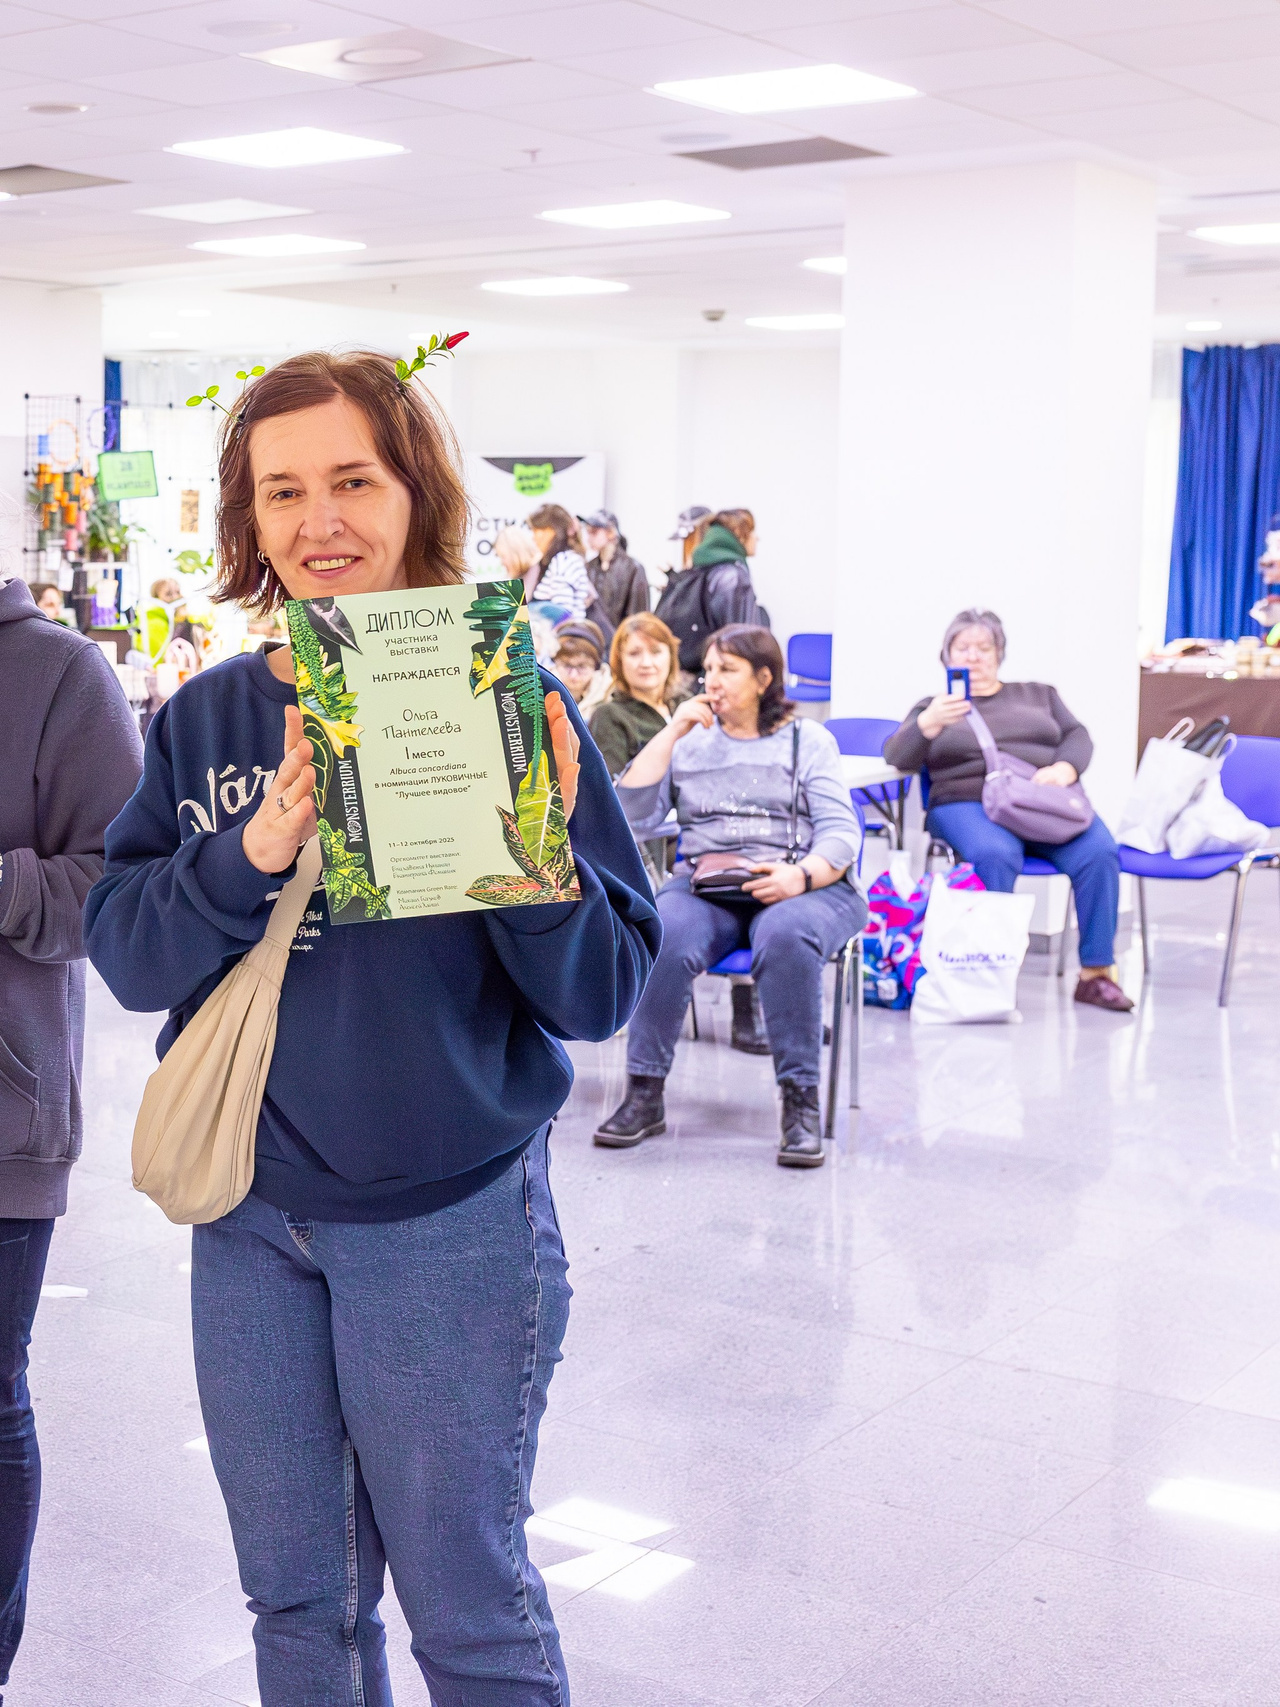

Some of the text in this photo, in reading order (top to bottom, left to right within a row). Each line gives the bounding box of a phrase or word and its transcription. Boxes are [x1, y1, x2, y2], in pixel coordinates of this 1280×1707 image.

[366, 607, 455, 634] ДИПЛОМ
[384, 633, 439, 647] участника
[389, 645, 439, 657] выставки
[372, 666, 461, 683] НАГРАЖДАЕТСЯ
[402, 708, 438, 722] Ольга
[381, 720, 462, 739] Пантелеева
[500, 691, 528, 774] MONSTERRIUM
[412, 749, 445, 760] место
[389, 762, 467, 776] Albuca concordiana
[381, 778, 429, 788] номинации
[430, 770, 488, 784] ЛУКОВИЧНЫЕ
[337, 759, 363, 844] MONSTERRIUM
[298, 926, 321, 939] Parks
